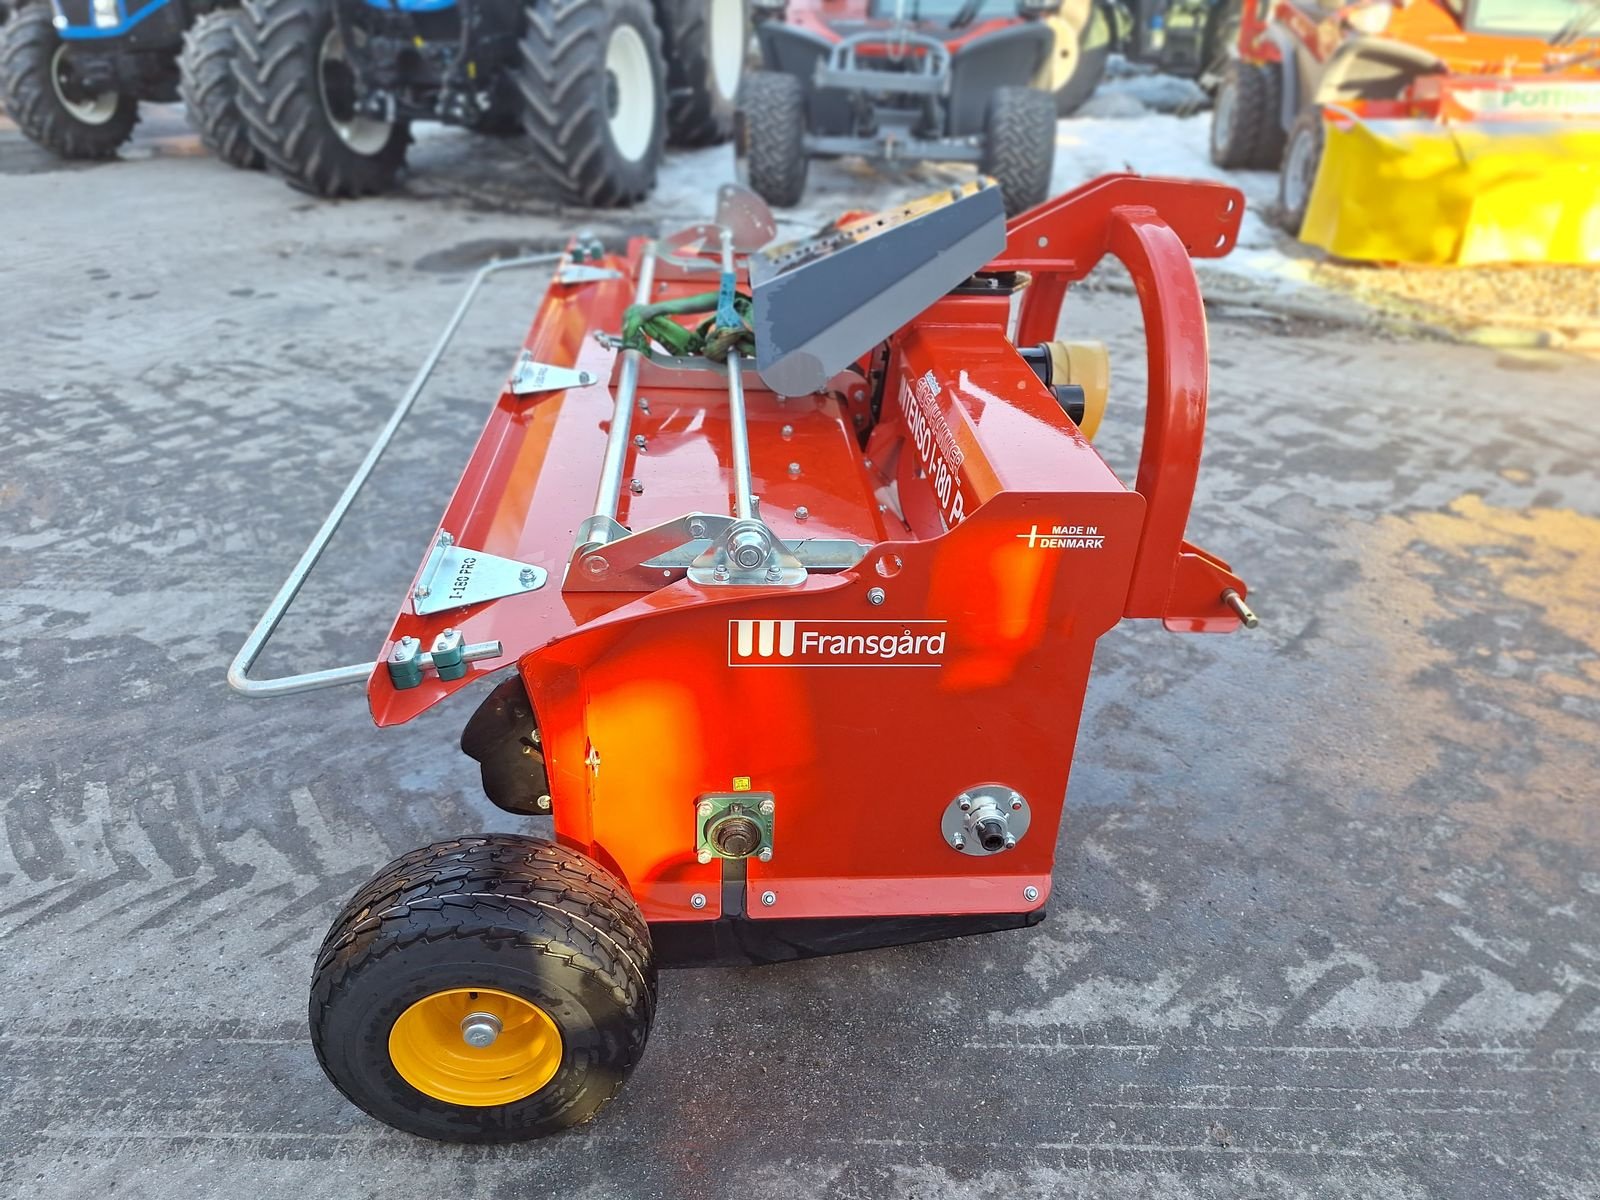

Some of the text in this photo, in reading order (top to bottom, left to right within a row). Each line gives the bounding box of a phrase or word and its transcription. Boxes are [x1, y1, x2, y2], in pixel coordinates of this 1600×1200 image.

[898, 374, 931, 462] INTENSO
[928, 442, 952, 509] I-180
[1040, 538, 1104, 549] DENMARK
[1051, 526, 1097, 535] MADE IN
[449, 557, 477, 599] I-180 PRO
[801, 629, 946, 659] Fransgård
